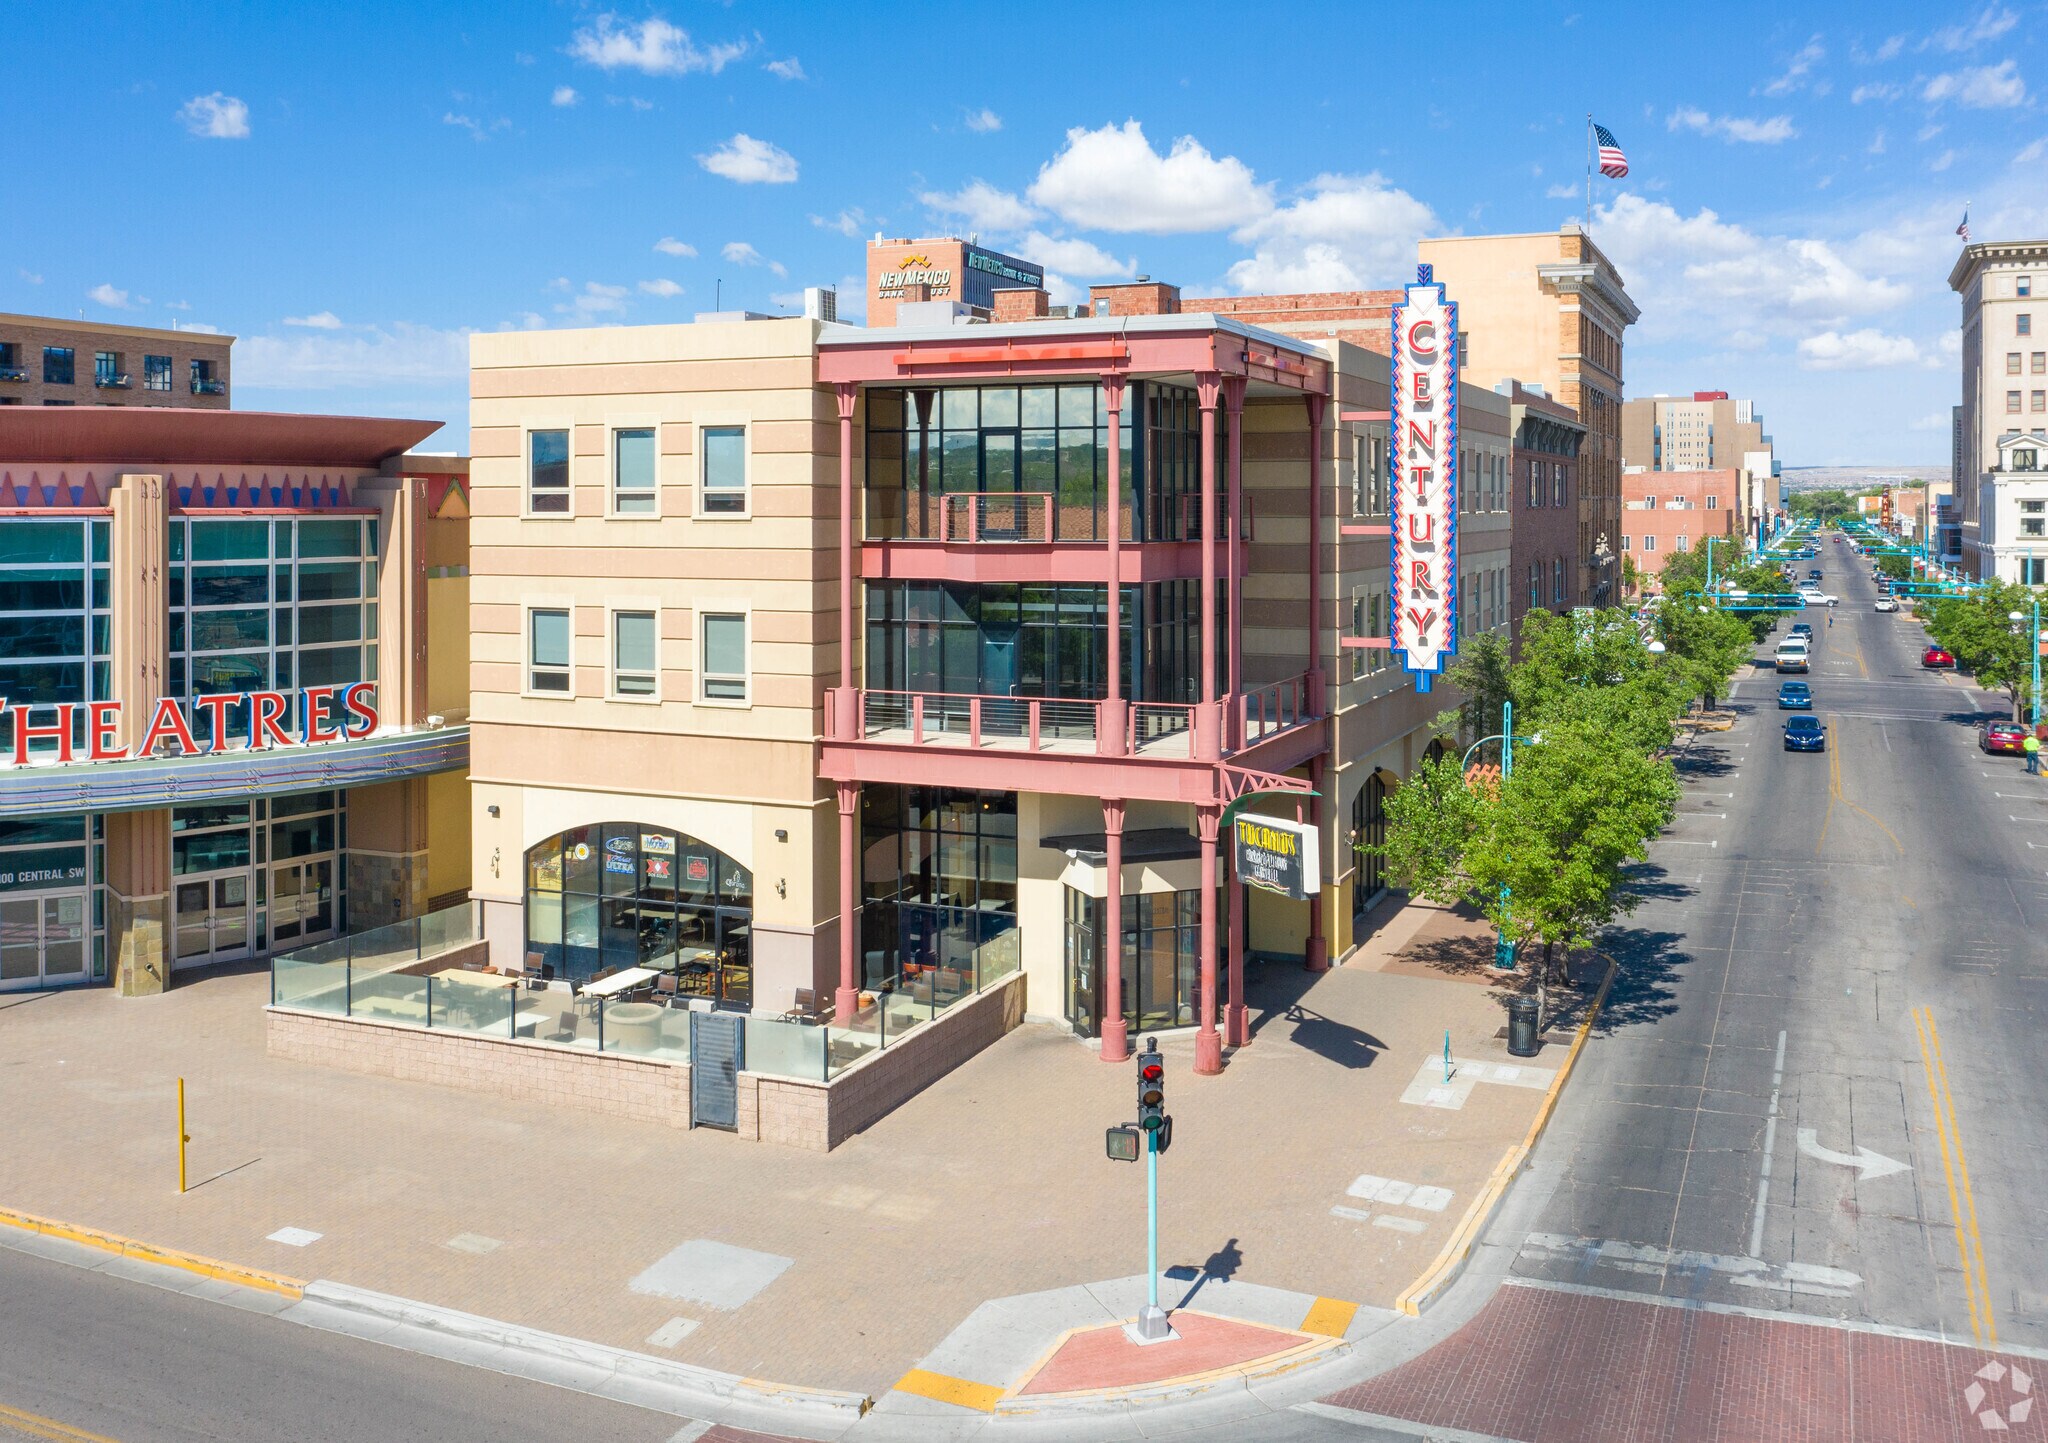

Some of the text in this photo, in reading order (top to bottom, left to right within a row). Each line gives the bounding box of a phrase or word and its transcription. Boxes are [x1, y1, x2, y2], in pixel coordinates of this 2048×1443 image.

[879, 288, 950, 298] BANK UST
[1408, 320, 1435, 638] CENTURY
[0, 682, 379, 766] HEATRES
[1237, 821, 1296, 856] TUCANOS
[0, 867, 85, 884] 00 CENTRAL SW
